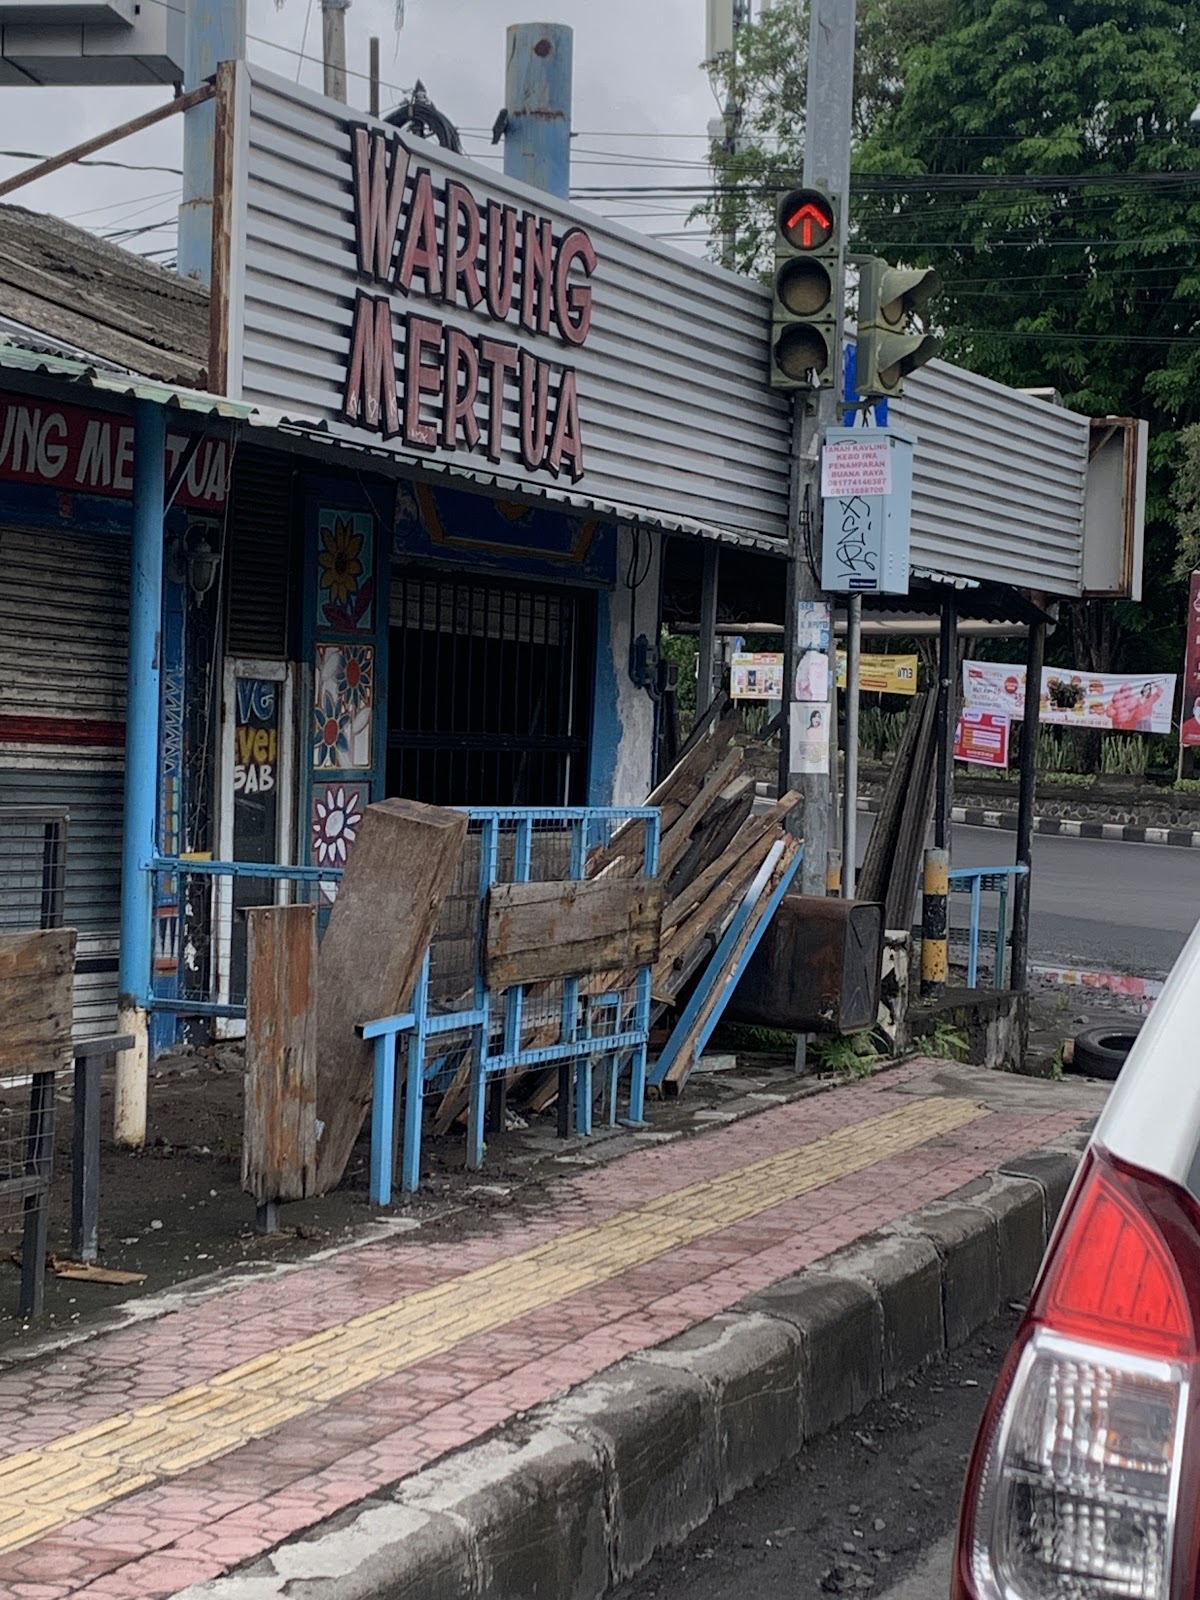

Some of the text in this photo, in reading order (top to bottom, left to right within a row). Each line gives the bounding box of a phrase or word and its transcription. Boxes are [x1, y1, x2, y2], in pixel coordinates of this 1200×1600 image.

[350, 119, 598, 347] WARUNG
[344, 287, 585, 484] MERTUA
[75, 420, 226, 501] METUA
[831, 469, 884, 478] BUANA RAYA
